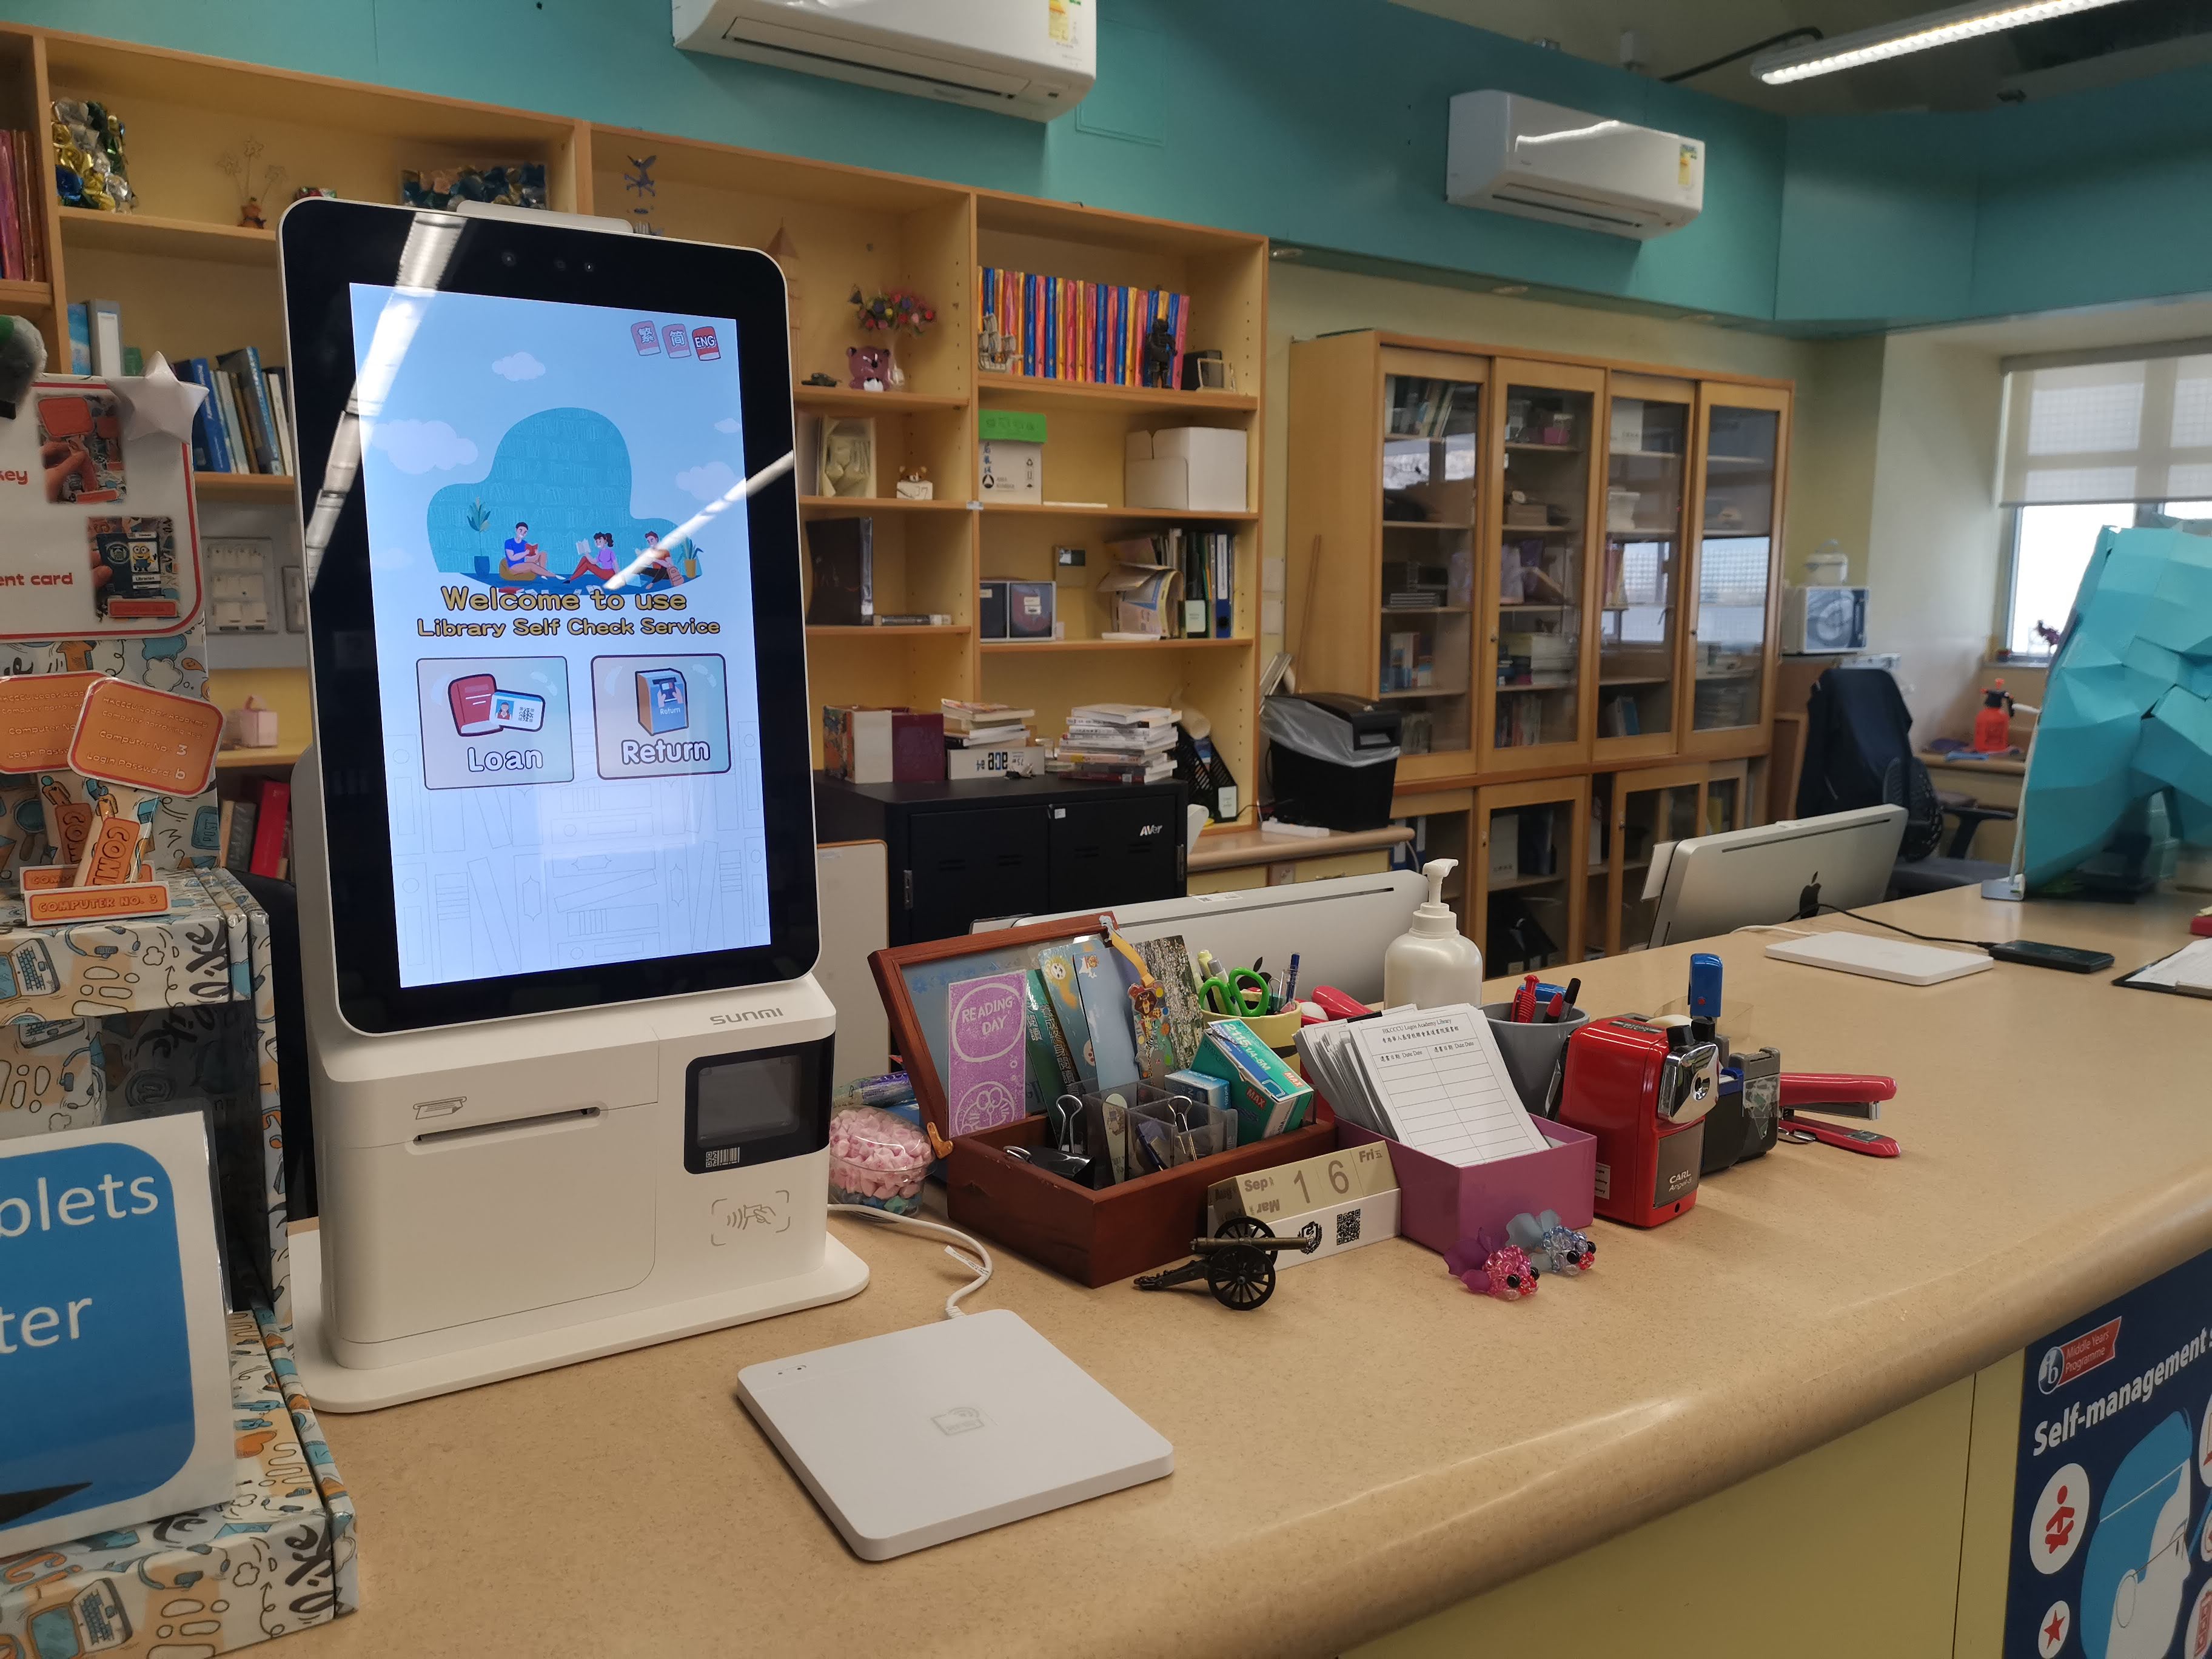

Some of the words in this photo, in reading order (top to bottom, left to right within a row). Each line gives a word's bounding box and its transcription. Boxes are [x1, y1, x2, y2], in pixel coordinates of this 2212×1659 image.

[637, 326, 655, 343] 繁
[695, 335, 716, 349] ENG
[30, 572, 73, 586] card
[440, 585, 581, 612] Welcome
[591, 588, 626, 611] to
[634, 592, 688, 612] use
[417, 618, 506, 638] Library
[513, 617, 561, 637] Self
[567, 617, 635, 637] Check
[640, 617, 722, 636] Service
[659, 706, 682, 716] Return
[8, 723, 59, 735] Computer
[99, 730, 150, 748] Computer
[176, 744, 188, 757] 3
[620, 738, 711, 766] Return
[87, 753, 115, 766] Login
[467, 746, 544, 773] Loan
[1139, 825, 1163, 837] AVer
[38, 896, 116, 913] COMPUTER
[120, 895, 145, 906] NO.
[149, 894, 158, 905] 3
[962, 996, 1013, 1023] READING
[982, 1014, 1008, 1036] DAY
[1224, 1023, 1252, 1048] 2115
[1382, 1025, 1404, 1034] HKCCCU
[1284, 1071, 1304, 1087] MAX
[1247, 1088, 1266, 1110] MAX
[1359, 1148, 1375, 1163] Fri
[1244, 1178, 1268, 1193] Sep
[1293, 1170, 1312, 1204] 1
[1328, 1159, 1349, 1195] 6
[1669, 1170, 1692, 1184] CARL
[1256, 1199, 1281, 1214] Mar
[0, 1298, 93, 1354] ter
[2066, 1339, 2091, 1359] Middle
[2092, 1331, 2110, 1347] Years
[2065, 1347, 2106, 1374] Programme
[2033, 1326, 2208, 1456] Self-management
